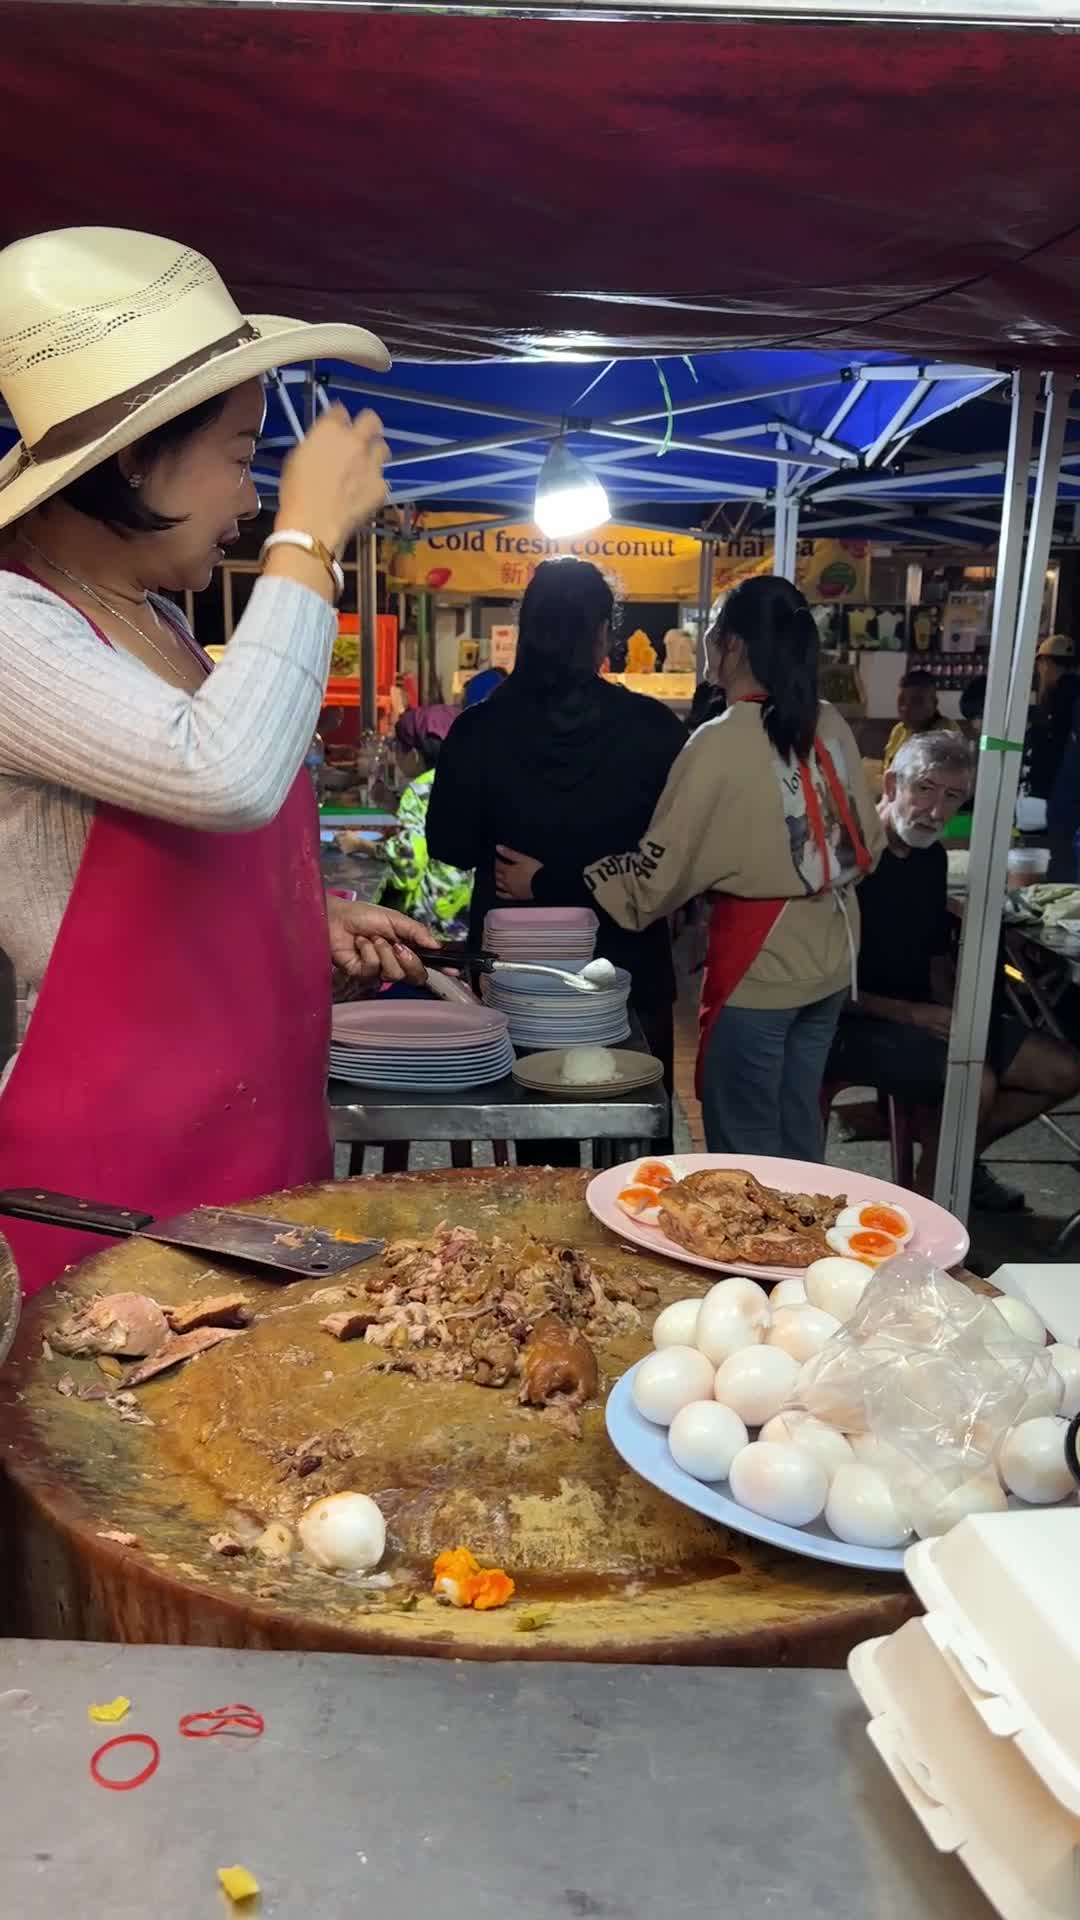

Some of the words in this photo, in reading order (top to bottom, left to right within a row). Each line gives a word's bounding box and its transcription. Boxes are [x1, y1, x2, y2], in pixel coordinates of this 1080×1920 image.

[428, 530, 485, 552] Cold
[495, 530, 560, 554] fresh
[570, 538, 676, 556] coconut
